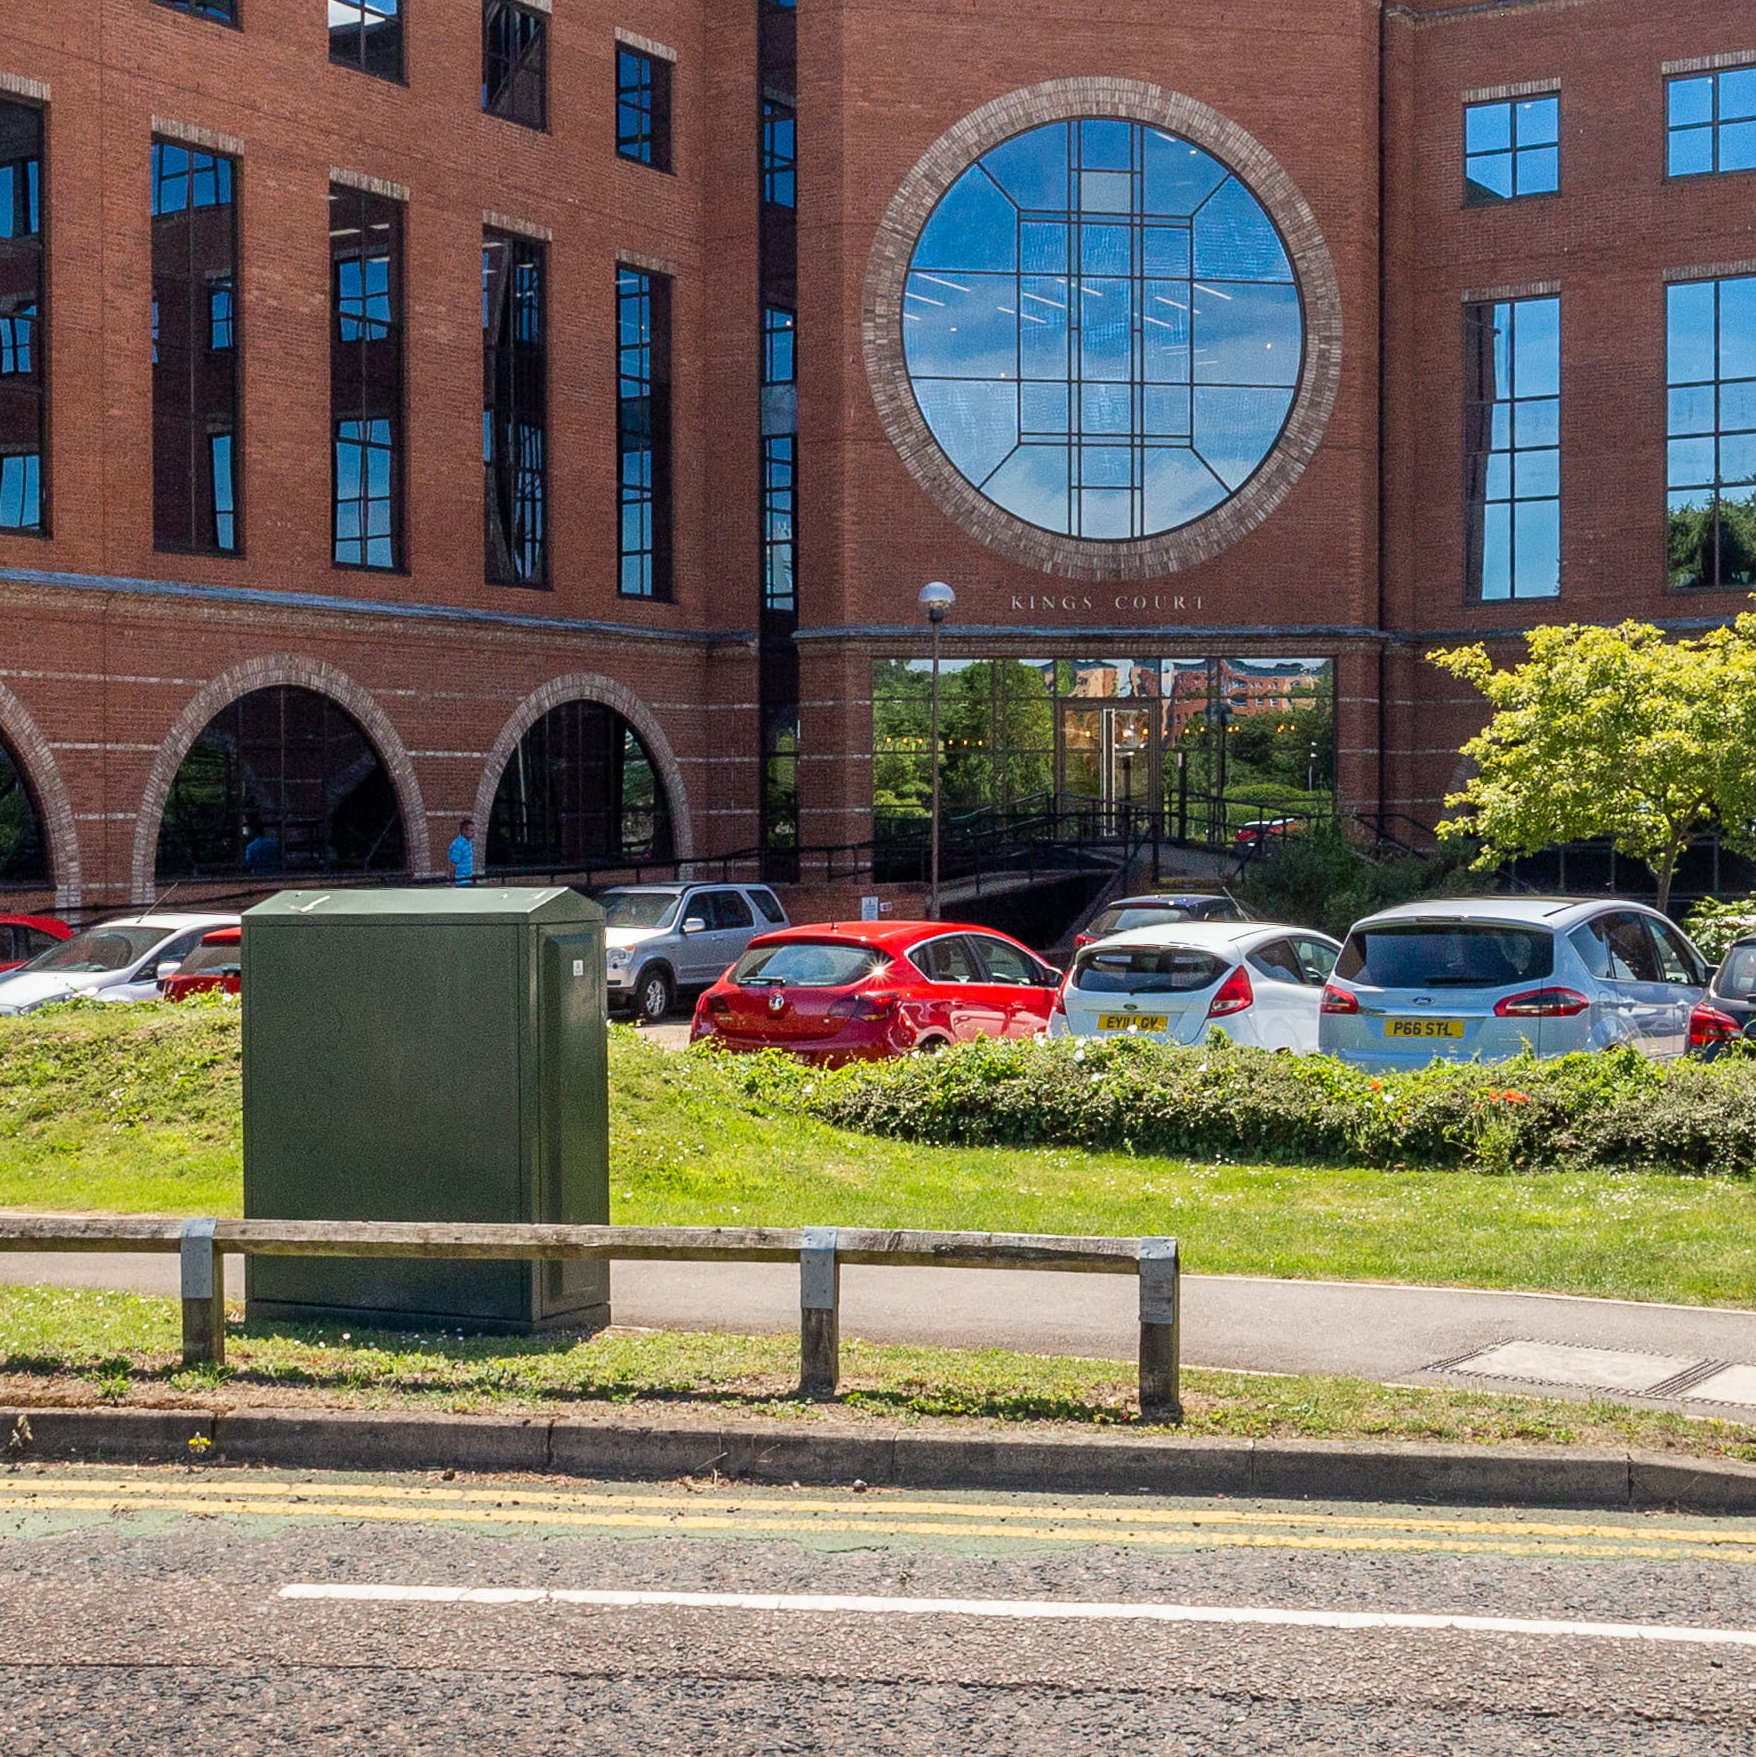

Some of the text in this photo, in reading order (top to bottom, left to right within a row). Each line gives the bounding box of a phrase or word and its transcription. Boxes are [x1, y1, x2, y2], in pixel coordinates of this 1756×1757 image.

[1011, 595, 1205, 610] KINGS COURT
[1394, 1022, 1421, 1035] P66
